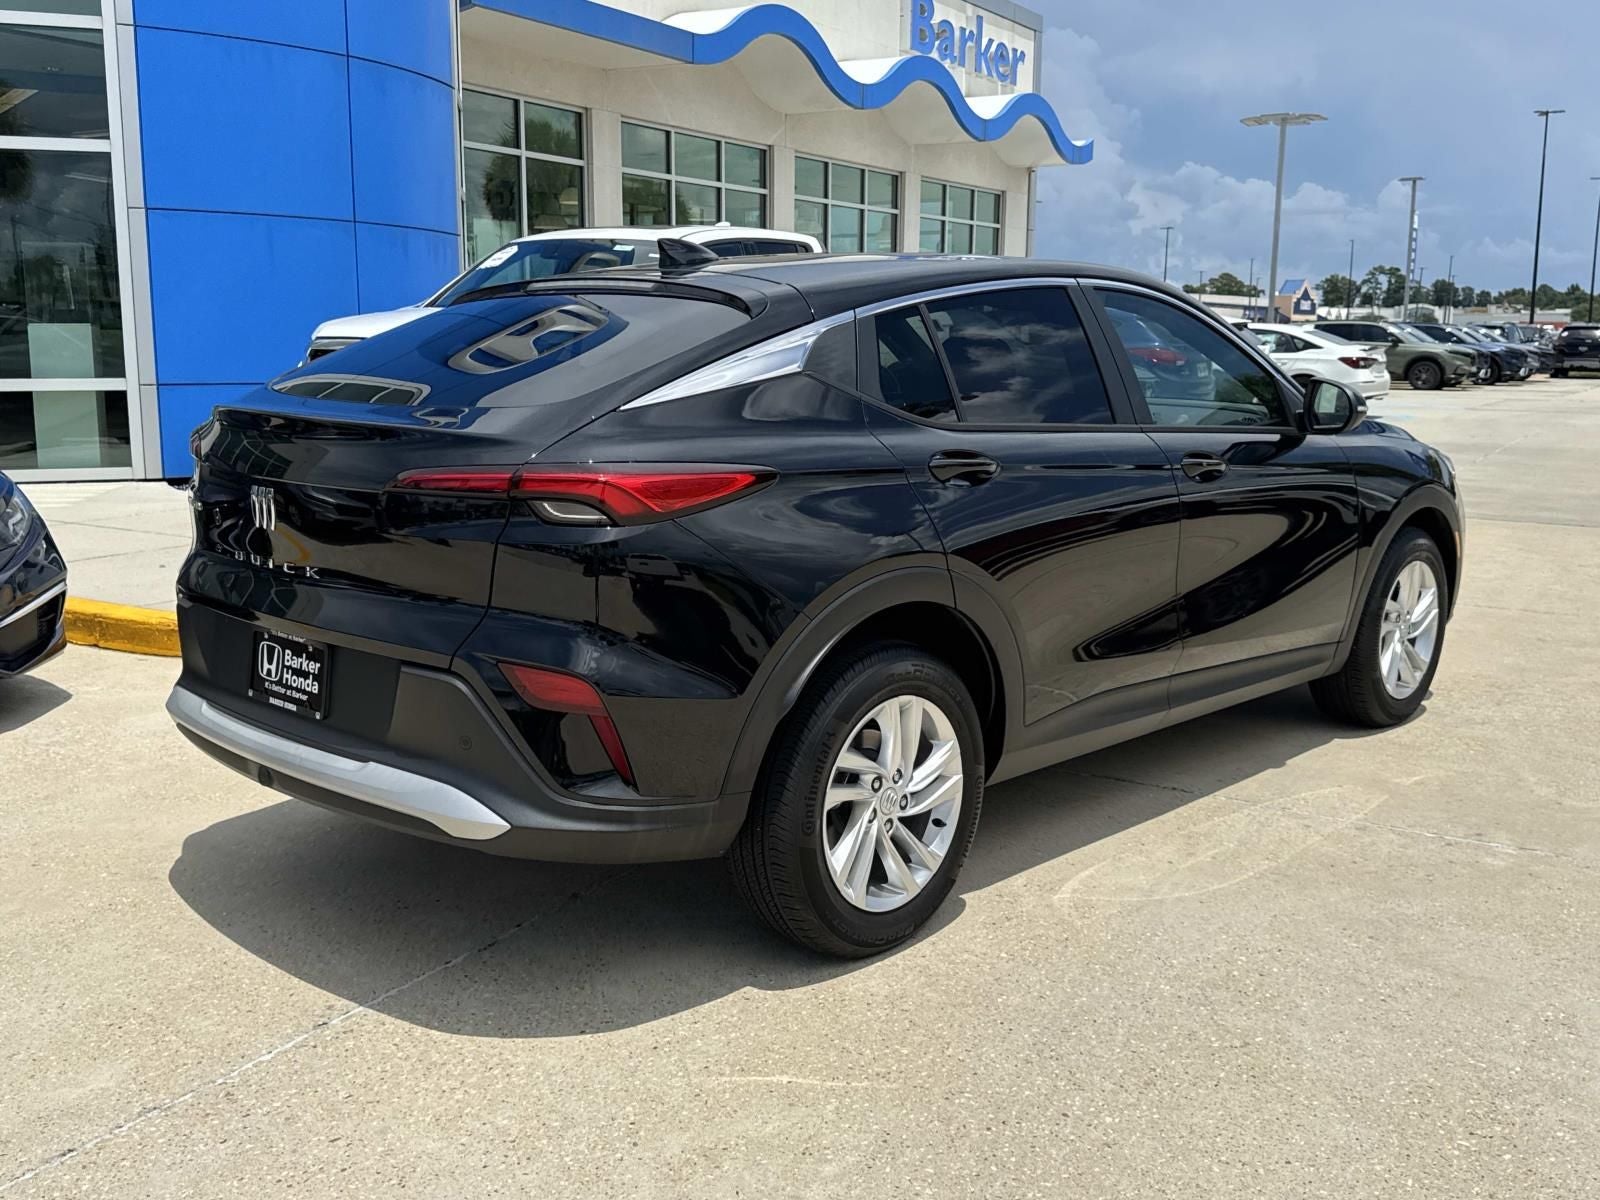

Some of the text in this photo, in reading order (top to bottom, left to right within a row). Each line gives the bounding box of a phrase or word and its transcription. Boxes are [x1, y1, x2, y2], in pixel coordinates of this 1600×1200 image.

[911, 0, 1026, 87] Barker
[284, 649, 321, 674] Barker
[282, 667, 319, 694] Honda
